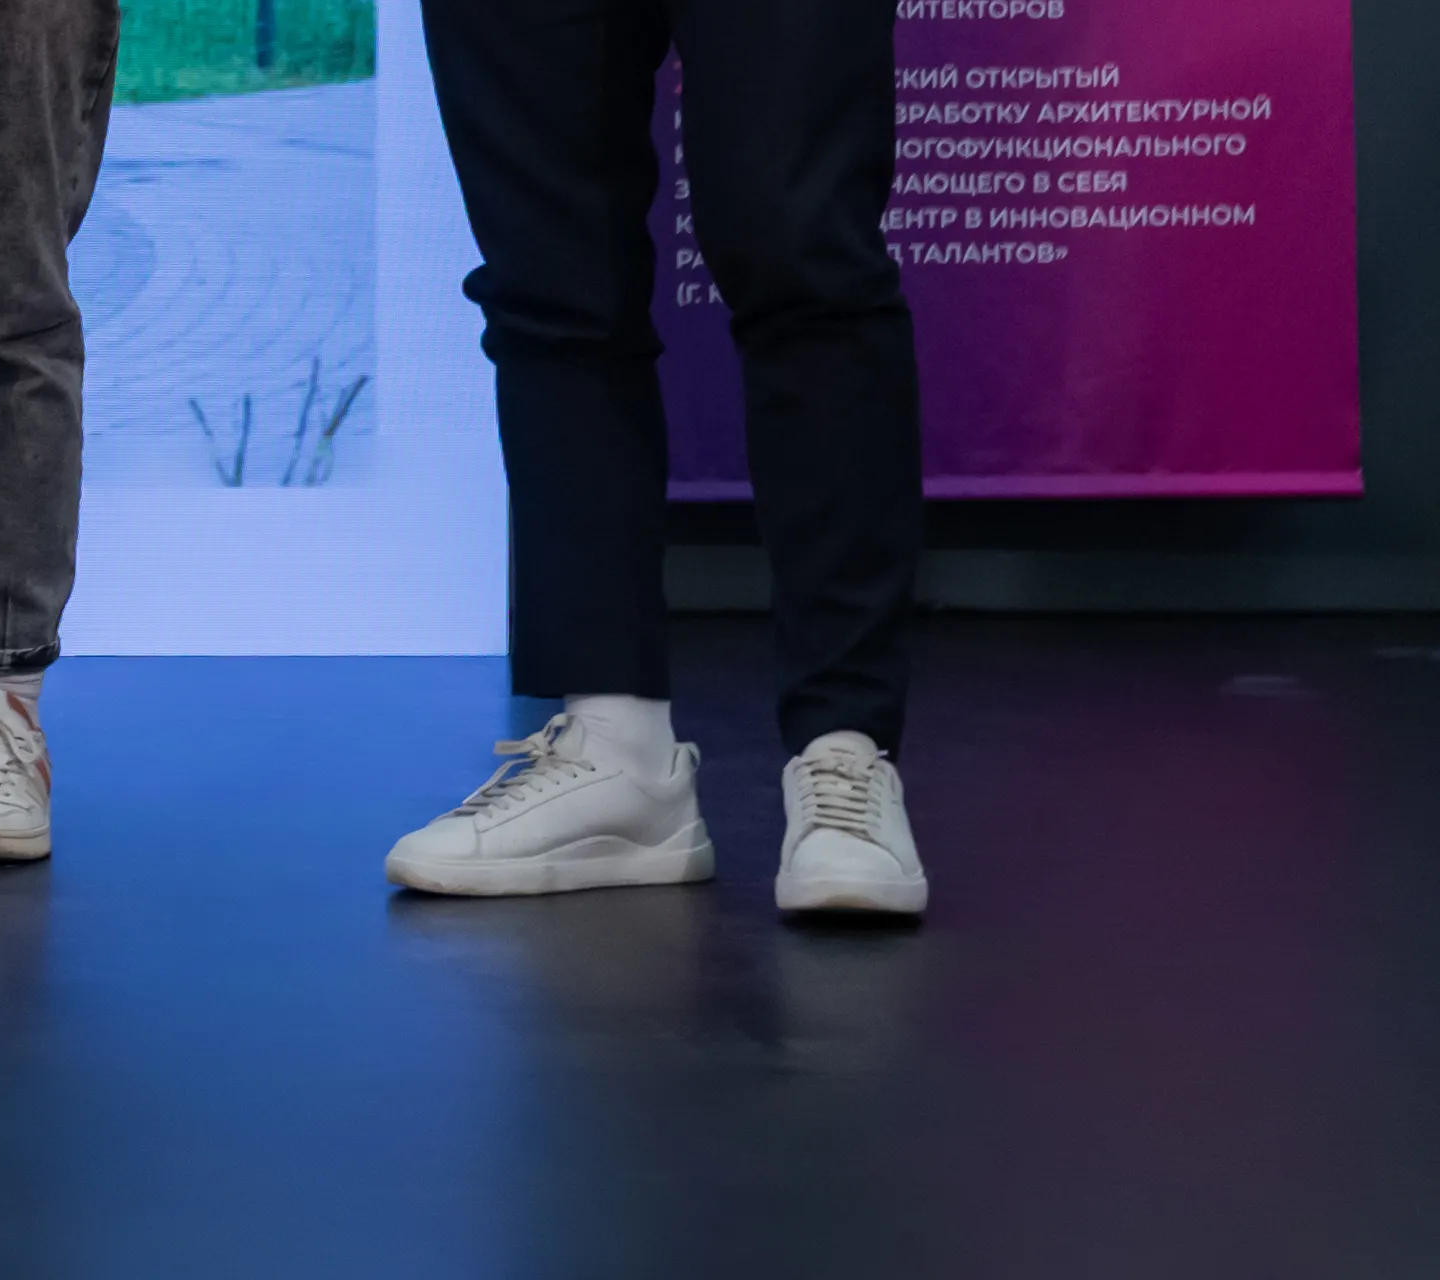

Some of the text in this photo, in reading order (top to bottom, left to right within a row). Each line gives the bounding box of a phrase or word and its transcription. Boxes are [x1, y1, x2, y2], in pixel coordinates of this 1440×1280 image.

[965, 62, 1120, 89] ОТКРЫТЫЙ
[1036, 94, 1272, 123] АРХИТЕКТУРНОЙ
[896, 134, 1247, 161] ОГОФУНКЦИОНАЛЬНОГО
[1033, 172, 1051, 194] В
[1057, 170, 1128, 193] СЕБЯ
[964, 207, 983, 229] В
[989, 203, 1256, 231] ИННОВАЦИОННОМ
[908, 242, 1068, 265] ТАЛАНТОВ»
